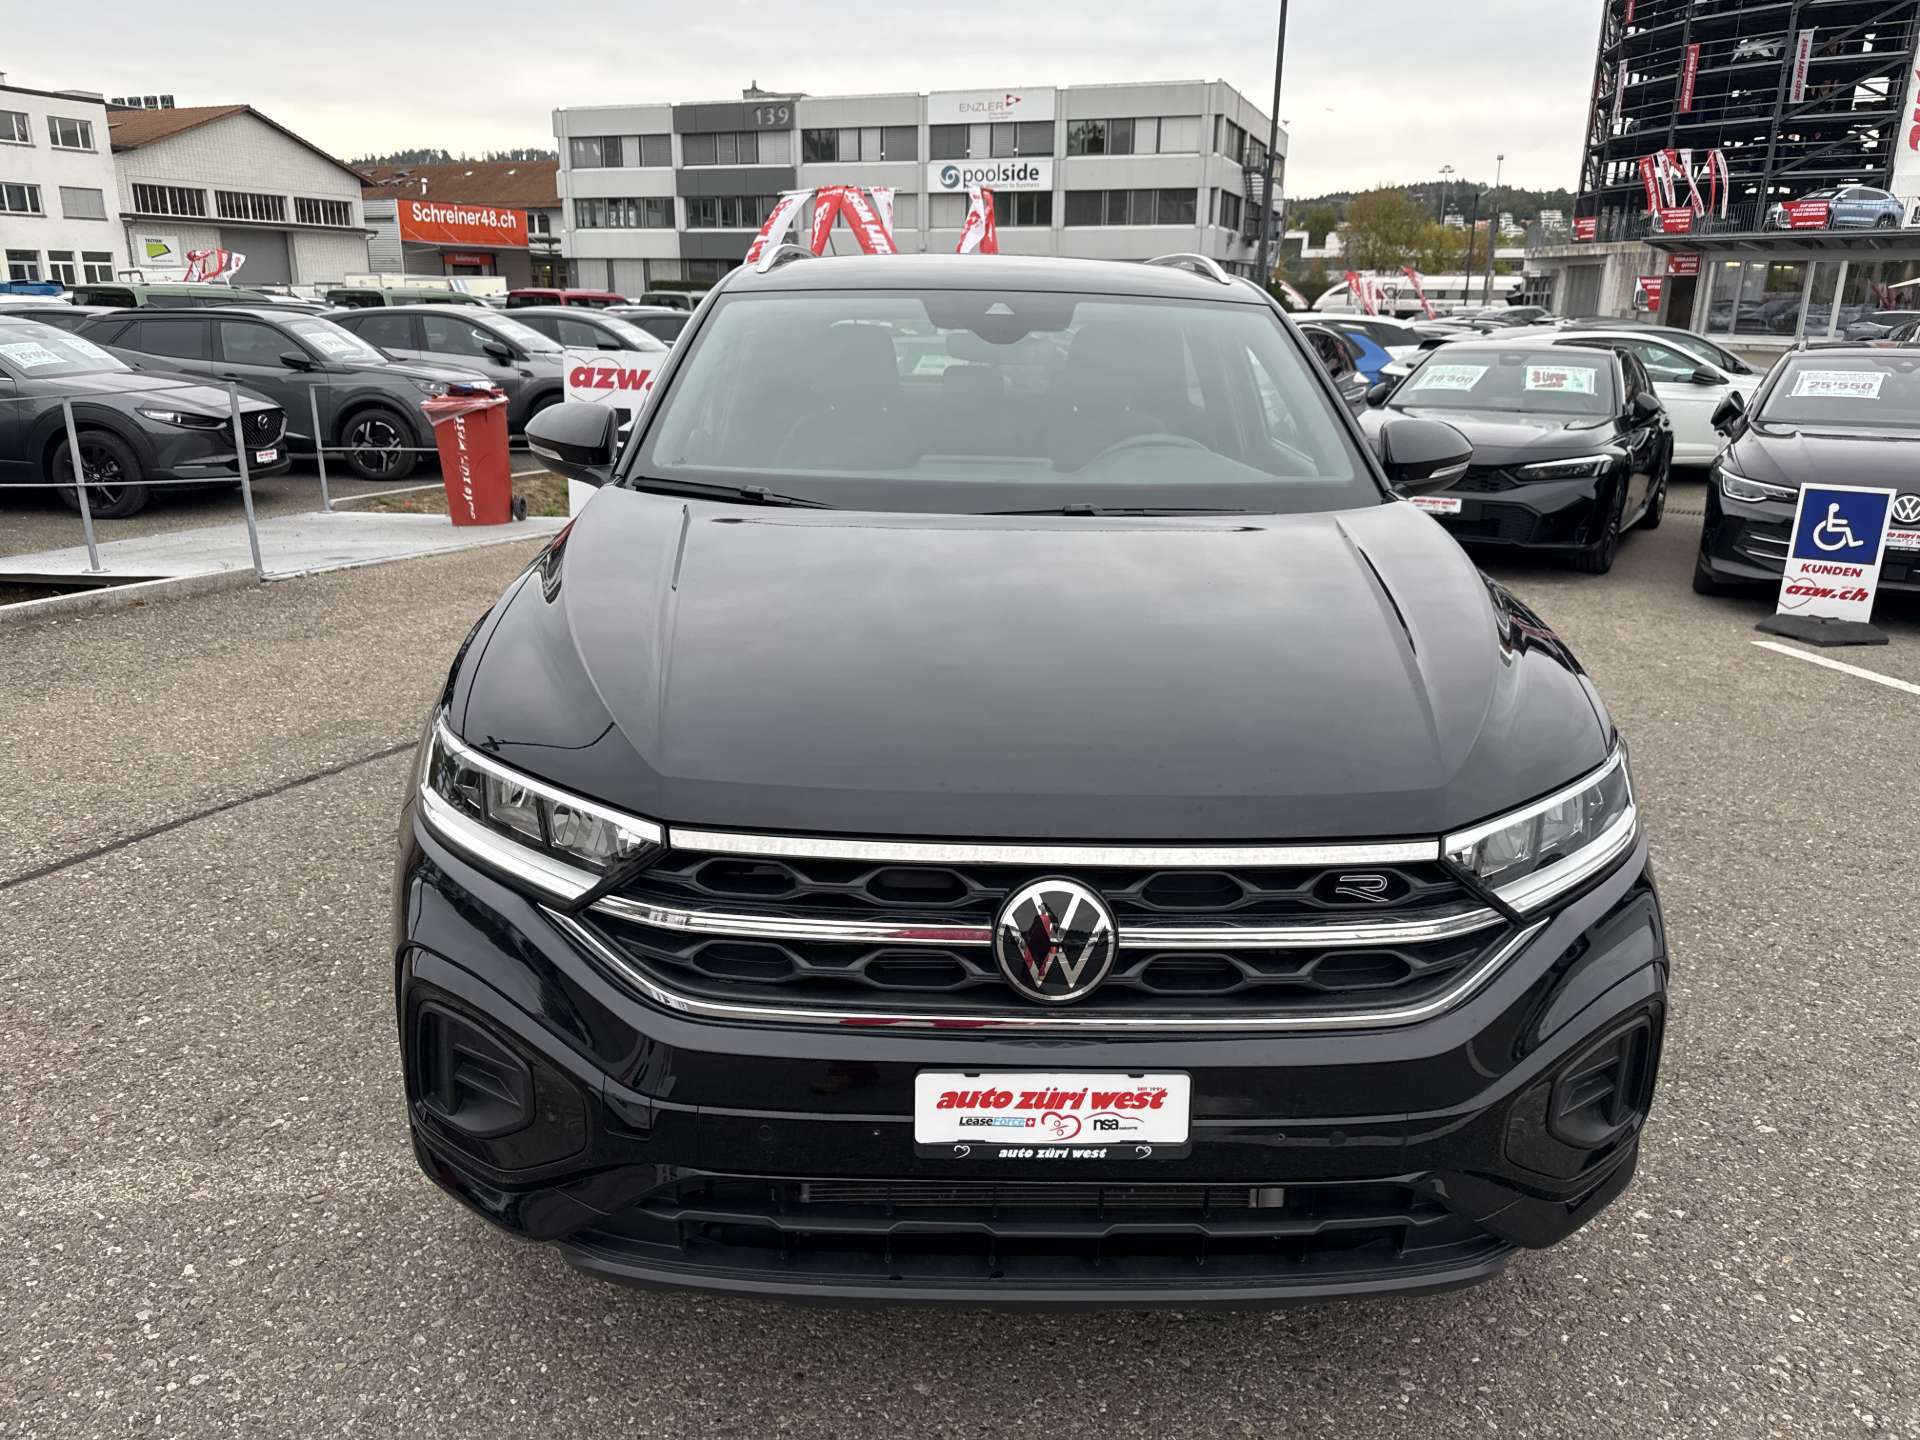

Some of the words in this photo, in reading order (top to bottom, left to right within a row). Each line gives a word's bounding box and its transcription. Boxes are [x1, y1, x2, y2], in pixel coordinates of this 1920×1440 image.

[959, 102, 1004, 112] ENZLER
[754, 106, 789, 125] 139
[963, 163, 1039, 188] poolside
[412, 202, 517, 229] Schreiner48.ch
[1807, 381, 1873, 390] 25'550
[1800, 563, 1863, 578] KUNDEN
[1785, 585, 1869, 602] azw.ch
[936, 1087, 1014, 1110] auto
[1014, 1087, 1089, 1110] züri
[1091, 1088, 1168, 1110] west
[959, 1116, 1026, 1127] LeaseForce
[1093, 1119, 1119, 1130] nsa
[998, 1147, 1034, 1158] auto
[1036, 1147, 1070, 1158] züri
[1072, 1147, 1107, 1158] west
